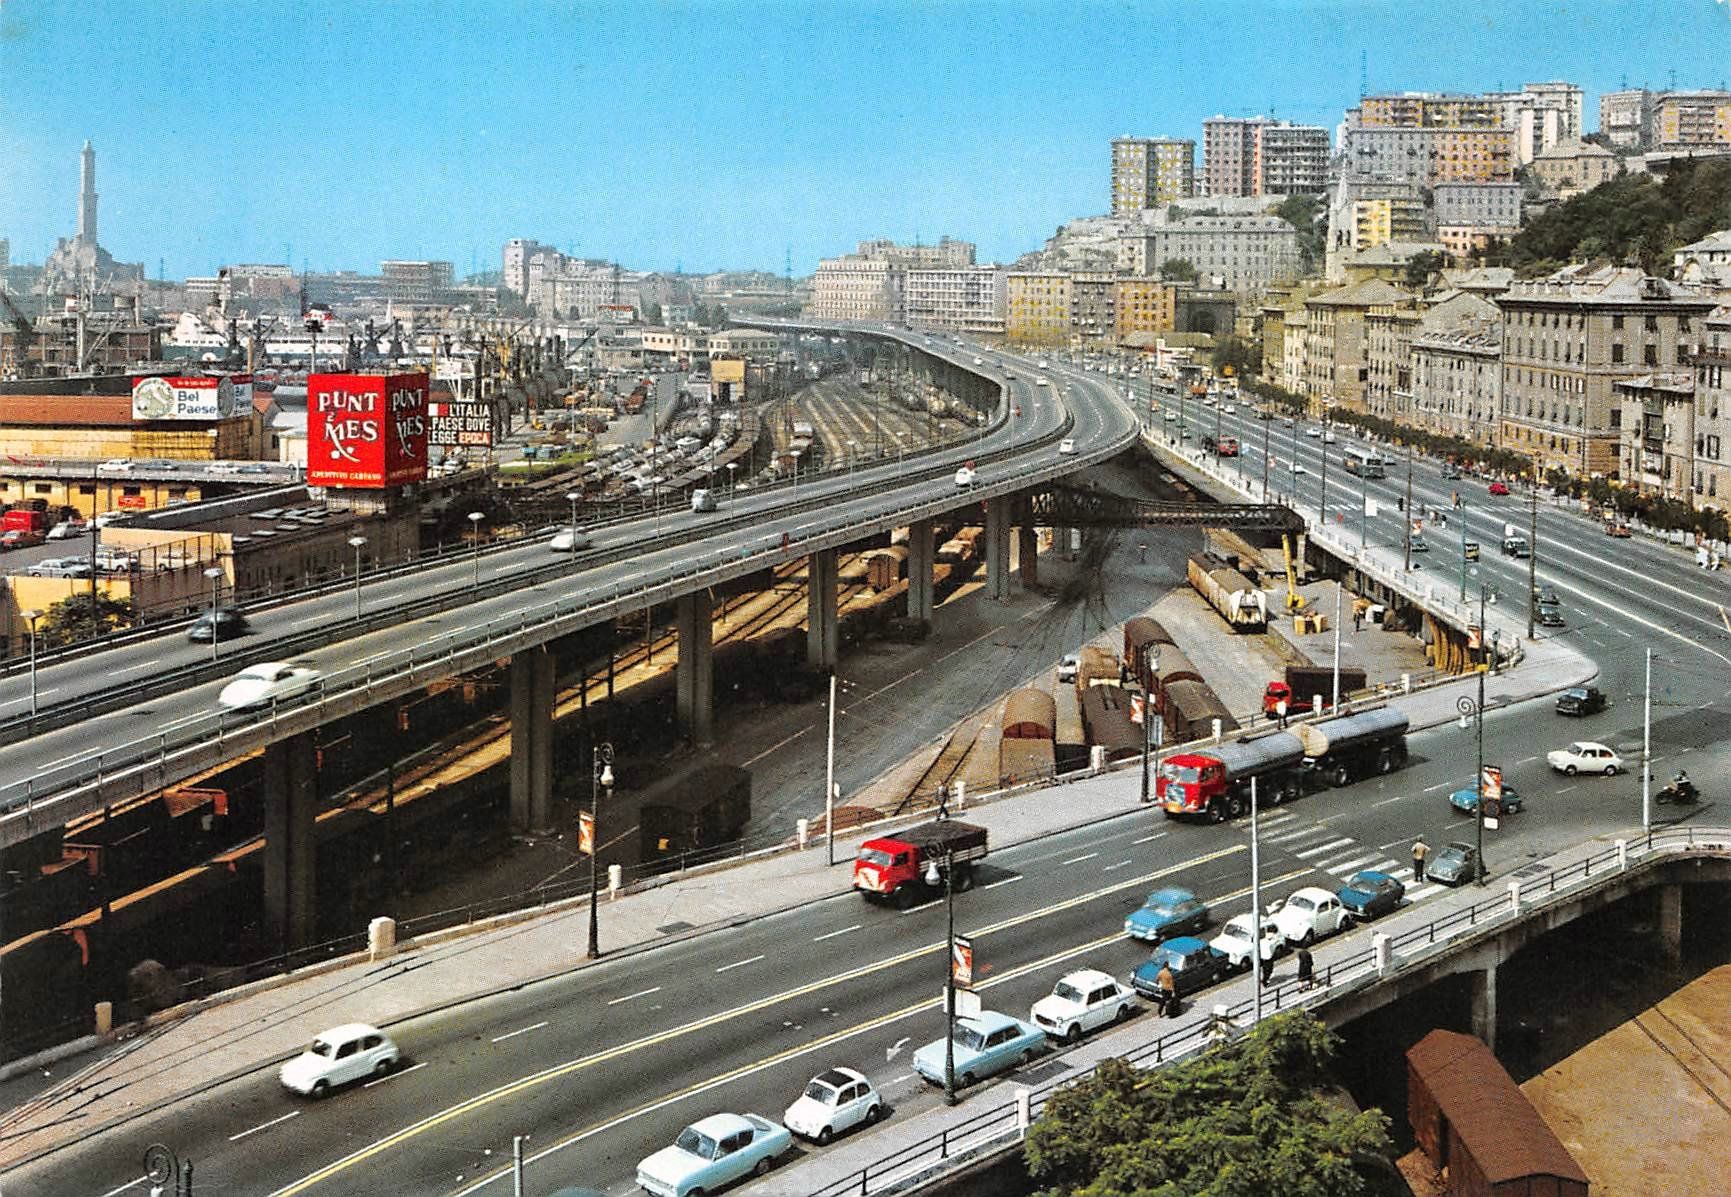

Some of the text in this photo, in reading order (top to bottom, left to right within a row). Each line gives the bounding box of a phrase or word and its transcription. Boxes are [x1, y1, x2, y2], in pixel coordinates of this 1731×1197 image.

[177, 390, 200, 402] Bel
[318, 391, 379, 412] PUNT
[392, 388, 424, 412] PUNT
[177, 403, 217, 414] Paese
[449, 403, 491, 417] L'ITALIA
[432, 417, 464, 431] PAESE
[466, 417, 491, 432] DOVE
[458, 431, 490, 444] EPOCA
